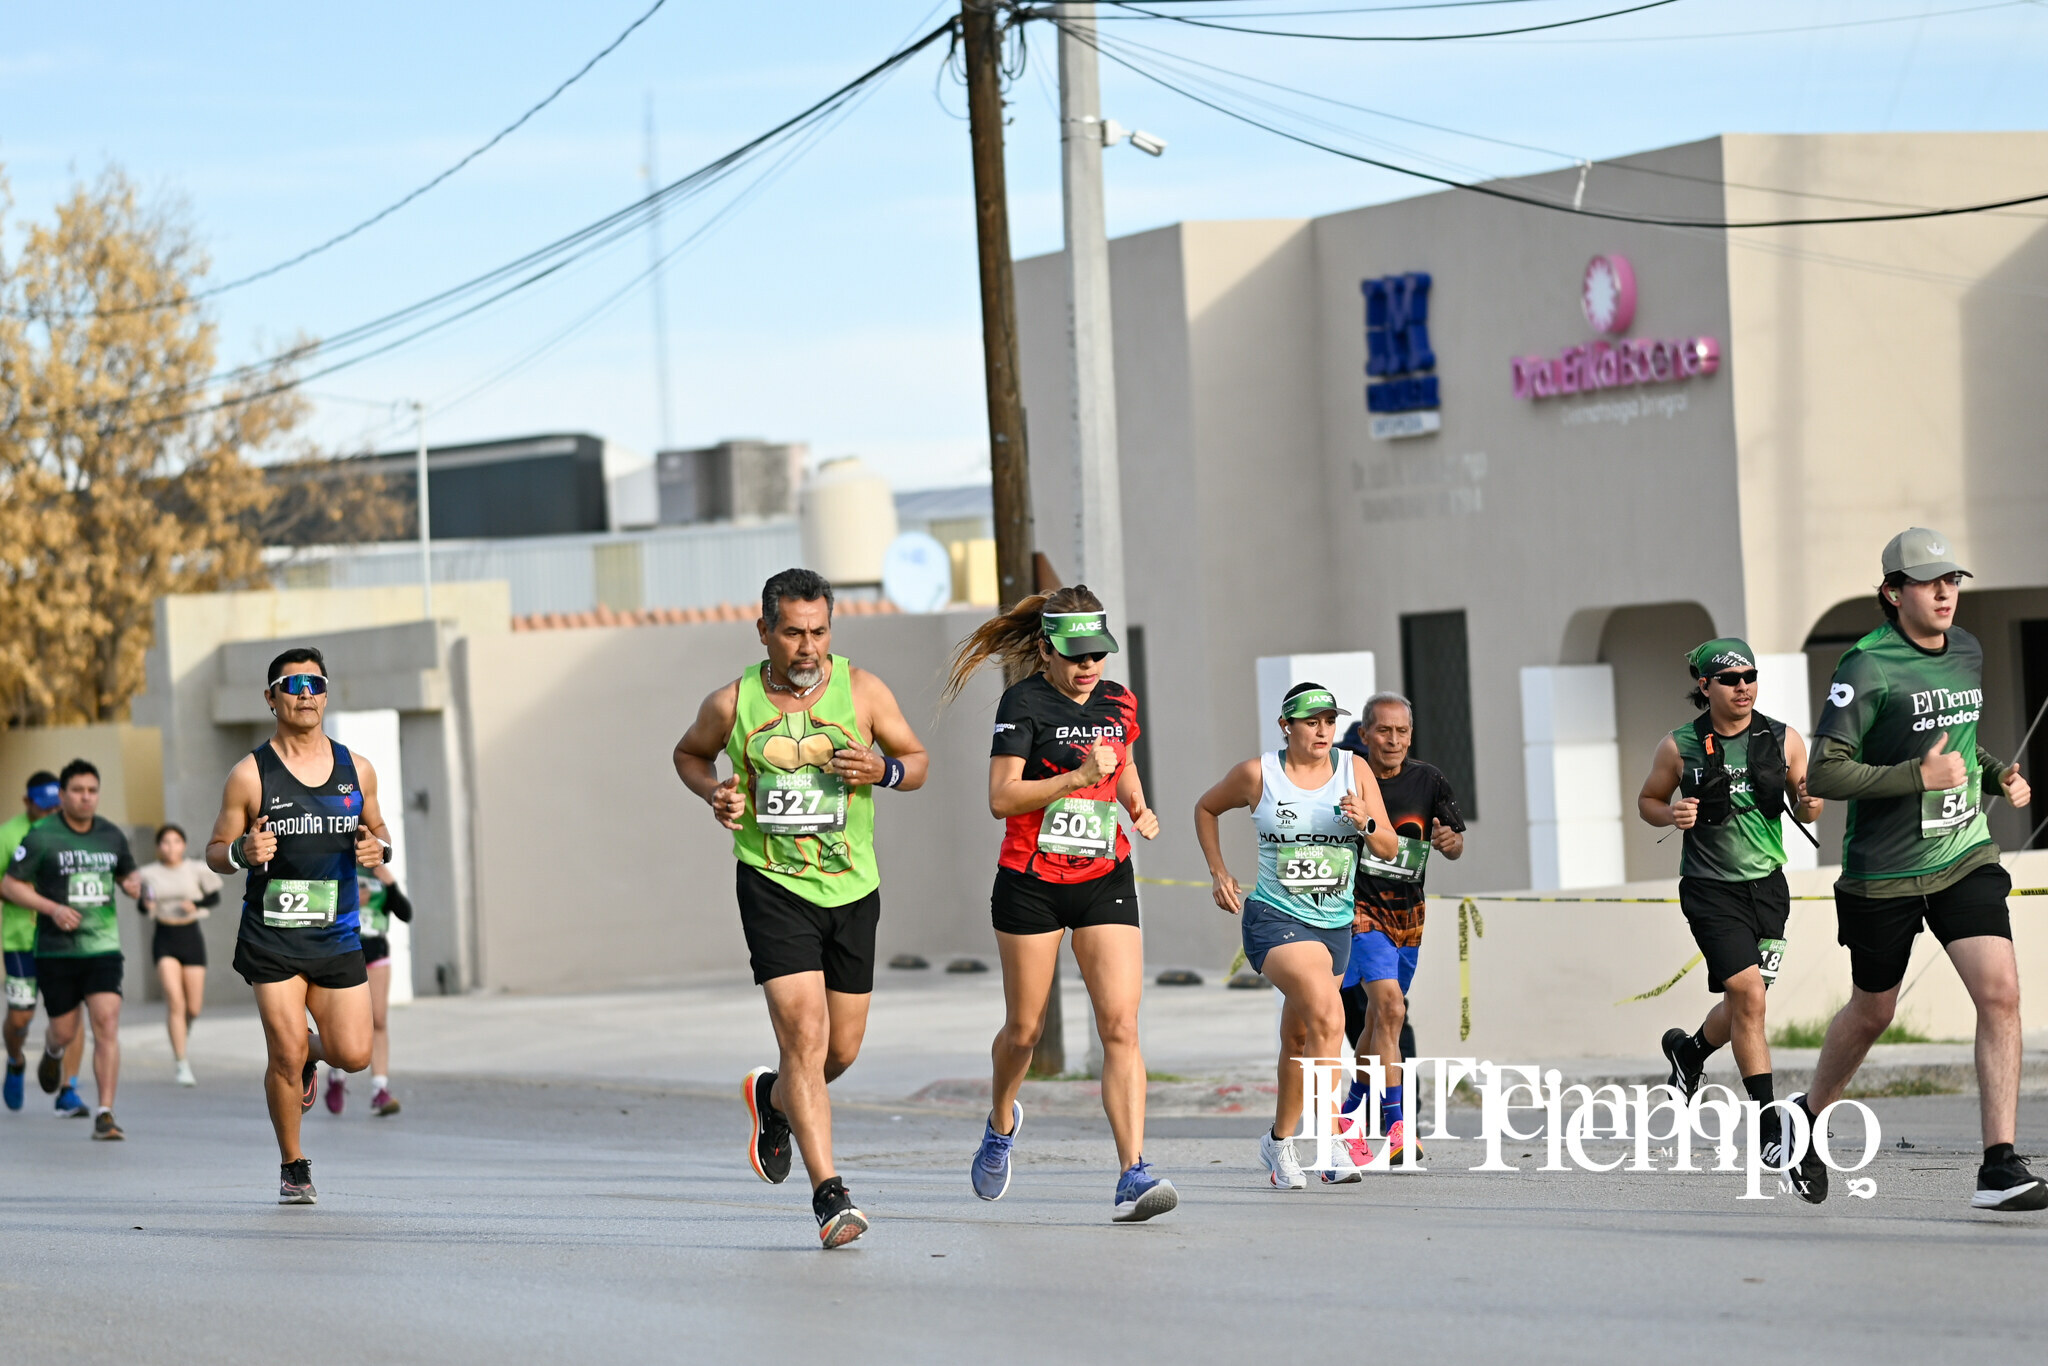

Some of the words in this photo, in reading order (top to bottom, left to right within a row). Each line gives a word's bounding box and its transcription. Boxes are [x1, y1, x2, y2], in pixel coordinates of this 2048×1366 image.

[1910, 690, 1934, 716] El
[1055, 726, 1123, 739] GALGOS
[1912, 716, 1935, 732] de
[1936, 710, 1980, 728] todos
[766, 789, 824, 815] 527
[836, 785, 845, 825] MEDALLA
[1942, 791, 1968, 819] 54
[327, 814, 359, 834] TEAM
[1050, 812, 1102, 840] 503
[1107, 815, 1116, 853] MEDALLA
[1286, 859, 1333, 879] 536
[1340, 855, 1351, 886] MEDALLA
[1413, 851, 1427, 880] MEDALLA
[76, 880, 104, 896] 101
[279, 892, 310, 913] 92
[327, 890, 337, 922] MEDALLA
